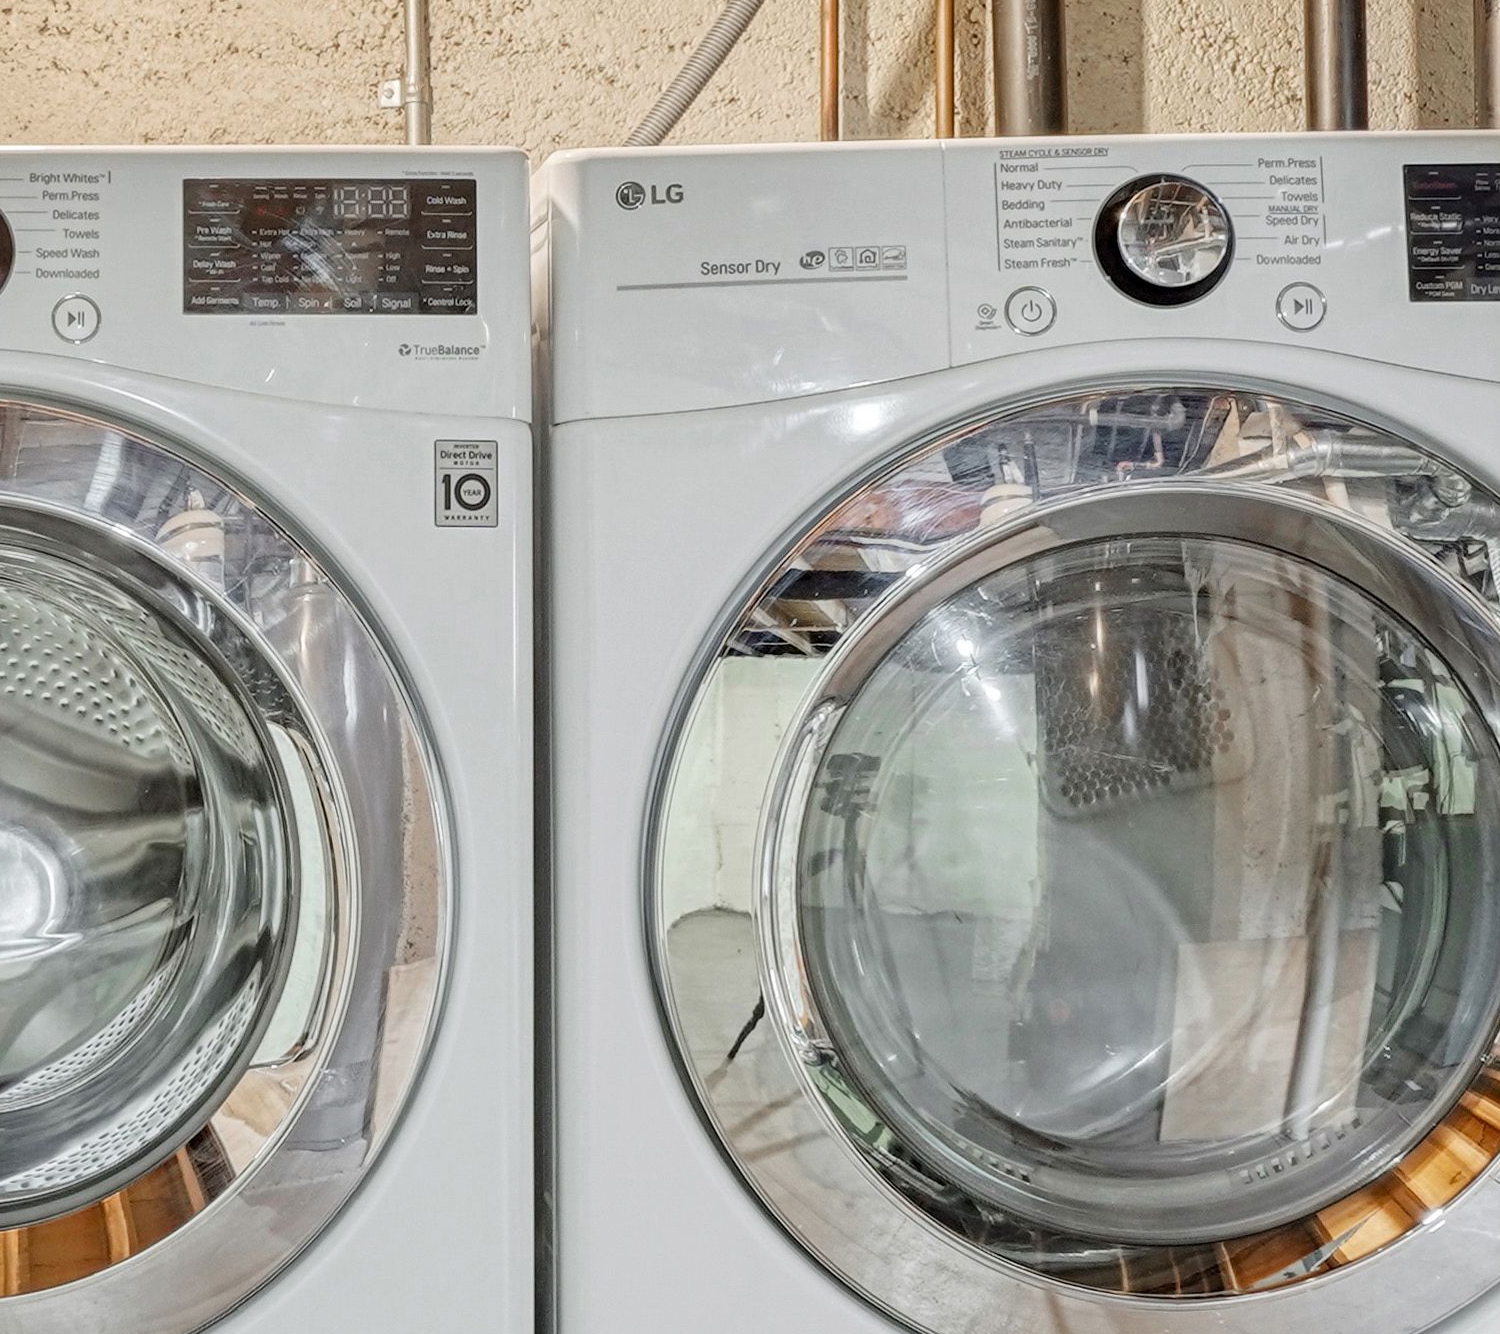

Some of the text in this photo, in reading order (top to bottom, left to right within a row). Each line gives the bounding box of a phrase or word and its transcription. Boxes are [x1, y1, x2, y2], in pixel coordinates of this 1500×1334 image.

[1000, 150, 1027, 158] STEAM
[1094, 148, 1109, 156] DRY
[1000, 163, 1038, 173] Normal
[29, 173, 61, 185] Bright
[1269, 175, 1318, 186] Delicates
[1001, 180, 1063, 192] Heavy Duty
[651, 183, 684, 205] LG
[1281, 191, 1318, 202] Towels
[1002, 199, 1045, 211] Bedding
[52, 210, 100, 221] Delicates
[1265, 215, 1319, 227] Speed Dry
[1003, 218, 1073, 229] Antibacterial
[63, 229, 100, 239] Towels
[1004, 239, 1035, 249] Steam
[1284, 235, 1320, 247] Air Dry
[36, 248, 100, 259] Speed Wash
[1004, 258, 1039, 269] Steam
[1256, 254, 1321, 265] Downloaded
[700, 259, 781, 276] Sensor Dry
[35, 268, 100, 279] Downloaded
[298, 297, 320, 309] Spin
[382, 298, 412, 310] Signal
[440, 450, 493, 460] Direct Drive
[441, 473, 491, 511] 10
